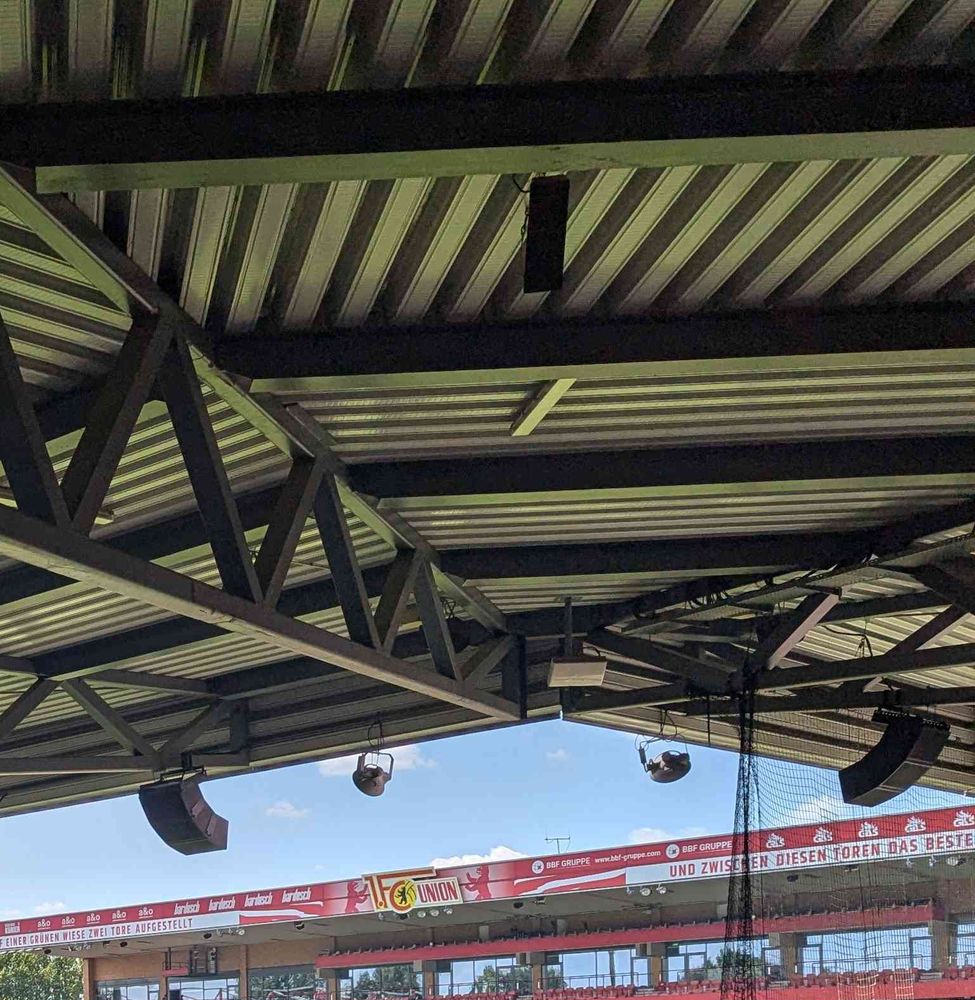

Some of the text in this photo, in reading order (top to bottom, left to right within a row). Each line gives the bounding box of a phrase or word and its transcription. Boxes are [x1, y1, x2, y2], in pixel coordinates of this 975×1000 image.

[670, 832, 973, 877] UND ZWISCEN DIESEN TOREN DAS BESTE
[682, 841, 733, 853] BBF GRUPPE
[546, 857, 590, 869] BBF GRUPPE
[594, 850, 661, 864] www.bbf-gruppe.com
[417, 880, 458, 903] UNION
[6, 937, 27, 947] EINER
[30, 933, 60, 944] GRÜNEN
[63, 930, 86, 941] WIESE
[89, 928, 107, 938] ZWEI
[112, 925, 131, 936] TORE
[135, 918, 193, 934] AUFGESTELLT
